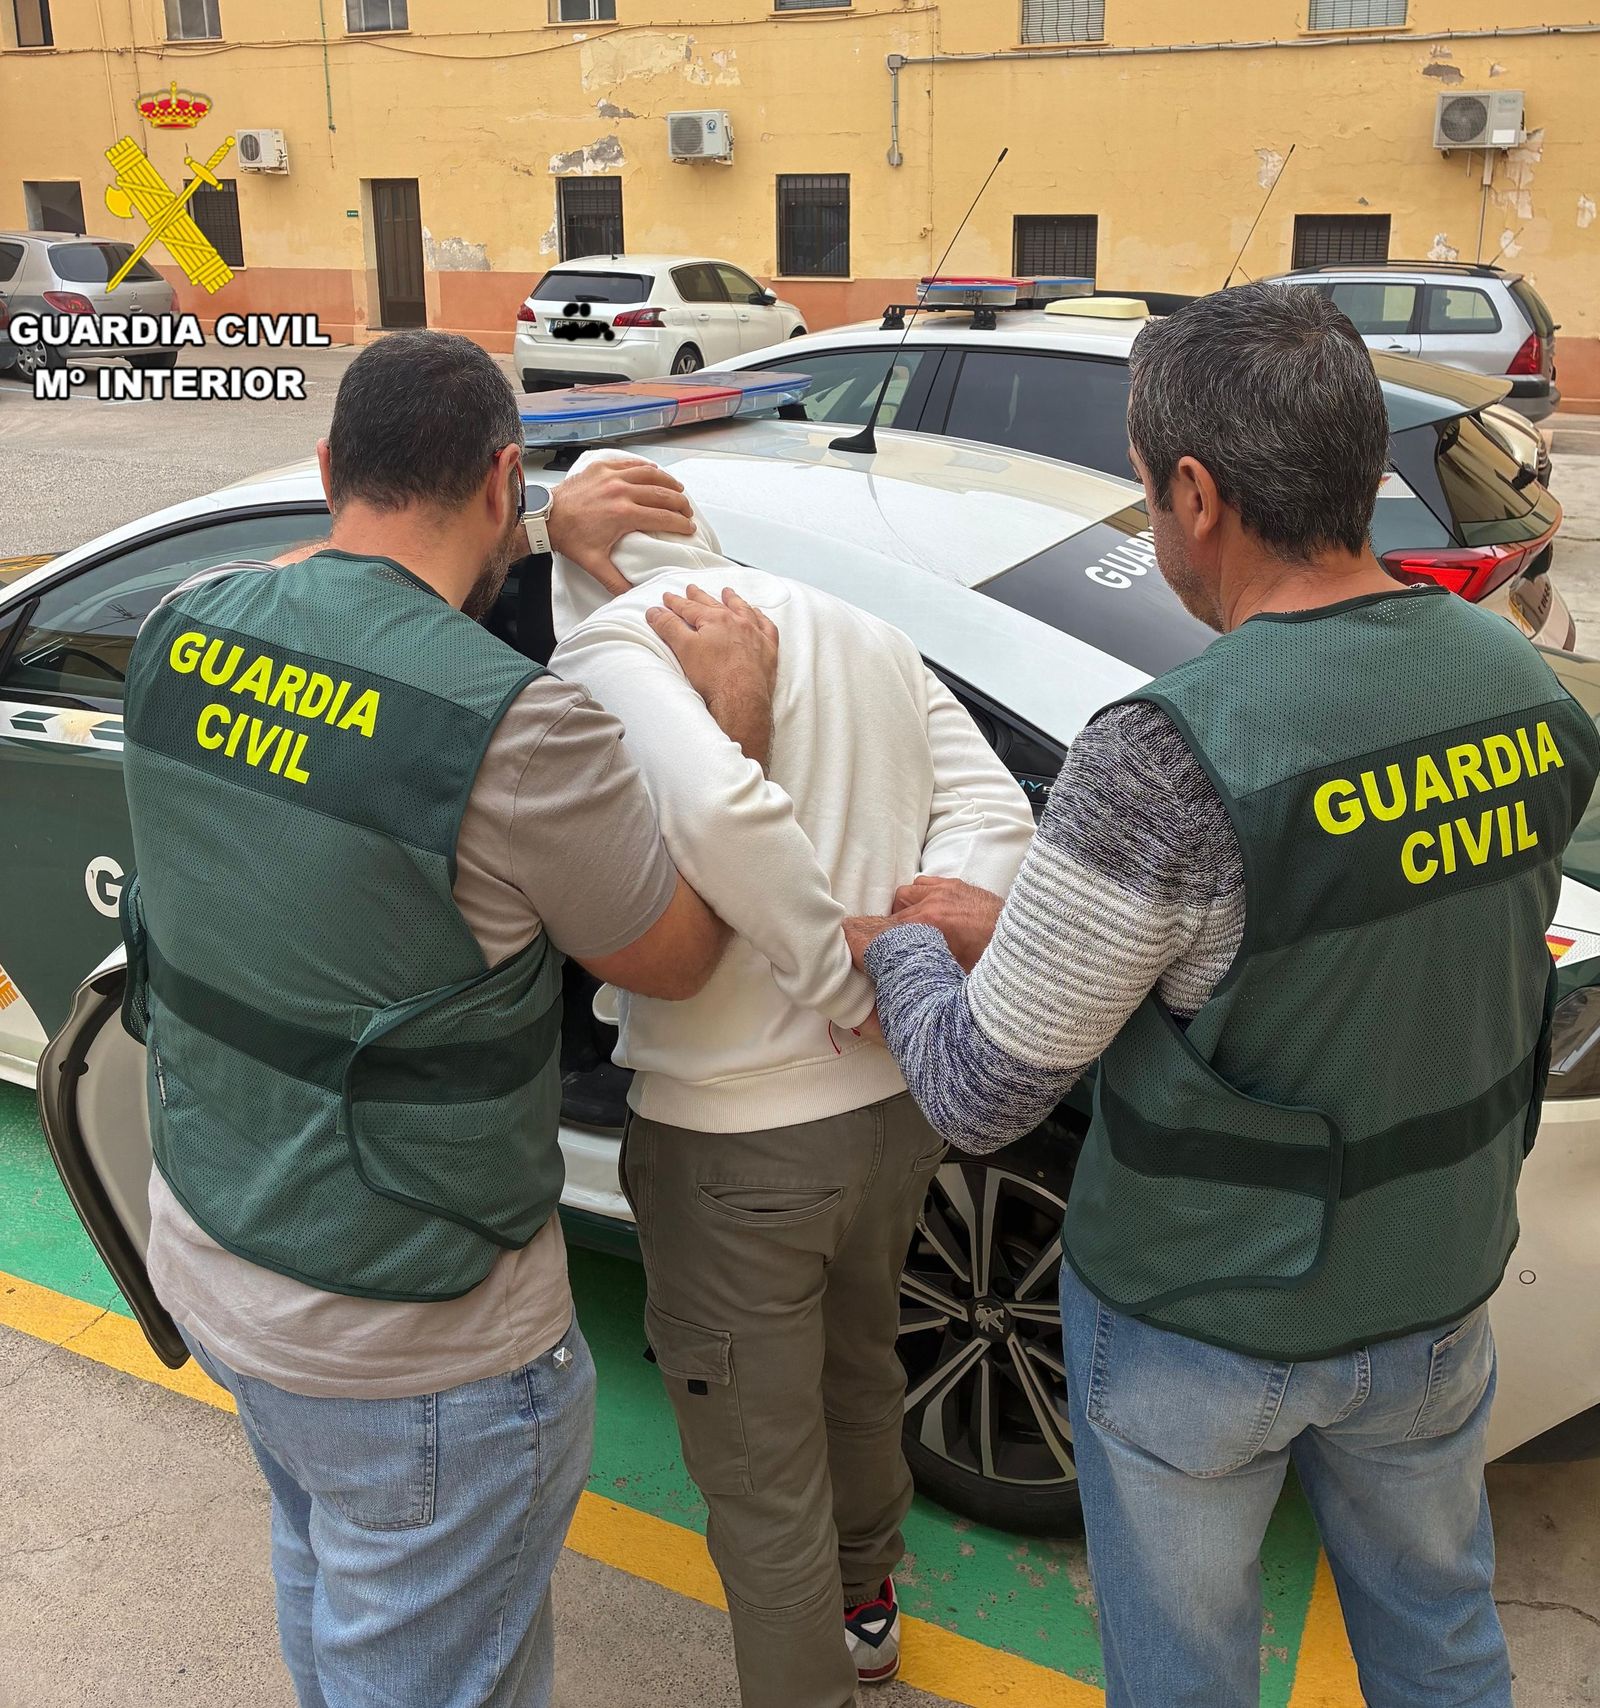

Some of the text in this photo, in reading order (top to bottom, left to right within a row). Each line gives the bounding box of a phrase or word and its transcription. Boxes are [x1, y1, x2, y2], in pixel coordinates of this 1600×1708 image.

[168, 630, 381, 739] GUARDIA
[195, 702, 311, 785] CIVIL
[1313, 721, 1565, 836] GUARDIA
[1400, 800, 1540, 886] CIVIL
